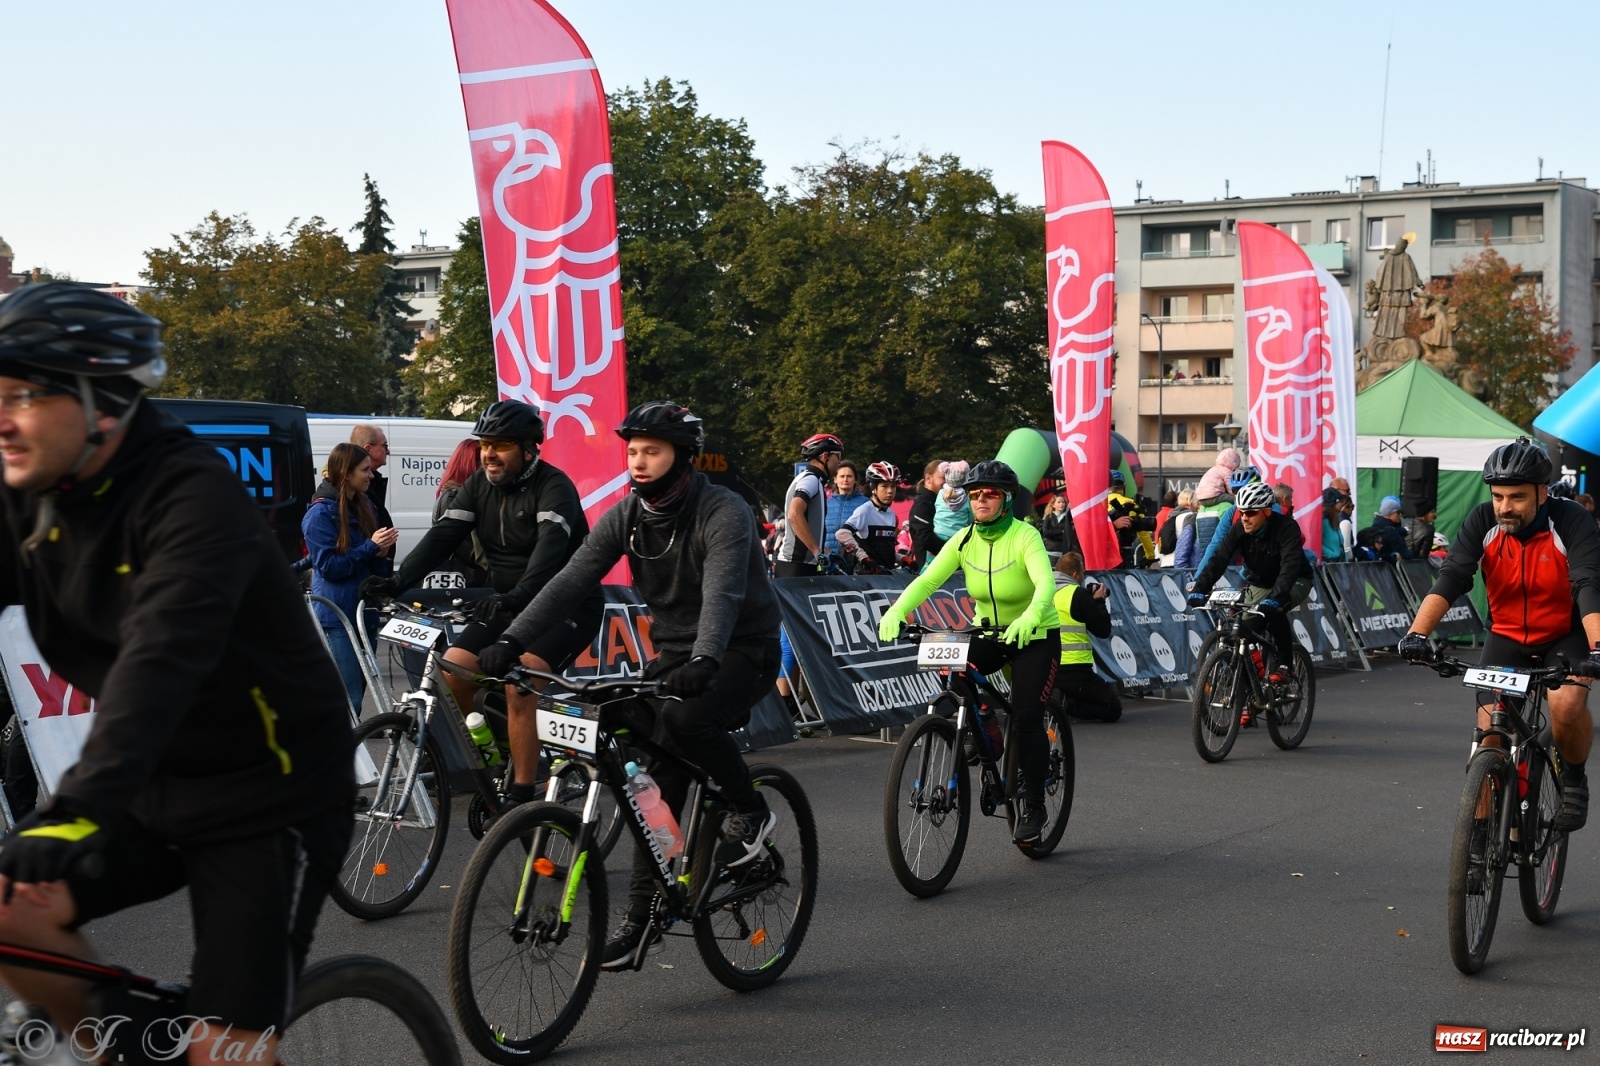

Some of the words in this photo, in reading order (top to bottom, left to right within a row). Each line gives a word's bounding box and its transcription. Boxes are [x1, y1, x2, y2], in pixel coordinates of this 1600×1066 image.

[393, 624, 430, 641] 3086
[928, 647, 960, 660] 3238
[1477, 673, 1518, 686] 3171
[549, 720, 587, 744] 3175
[622, 783, 676, 887] ROCKRIDER
